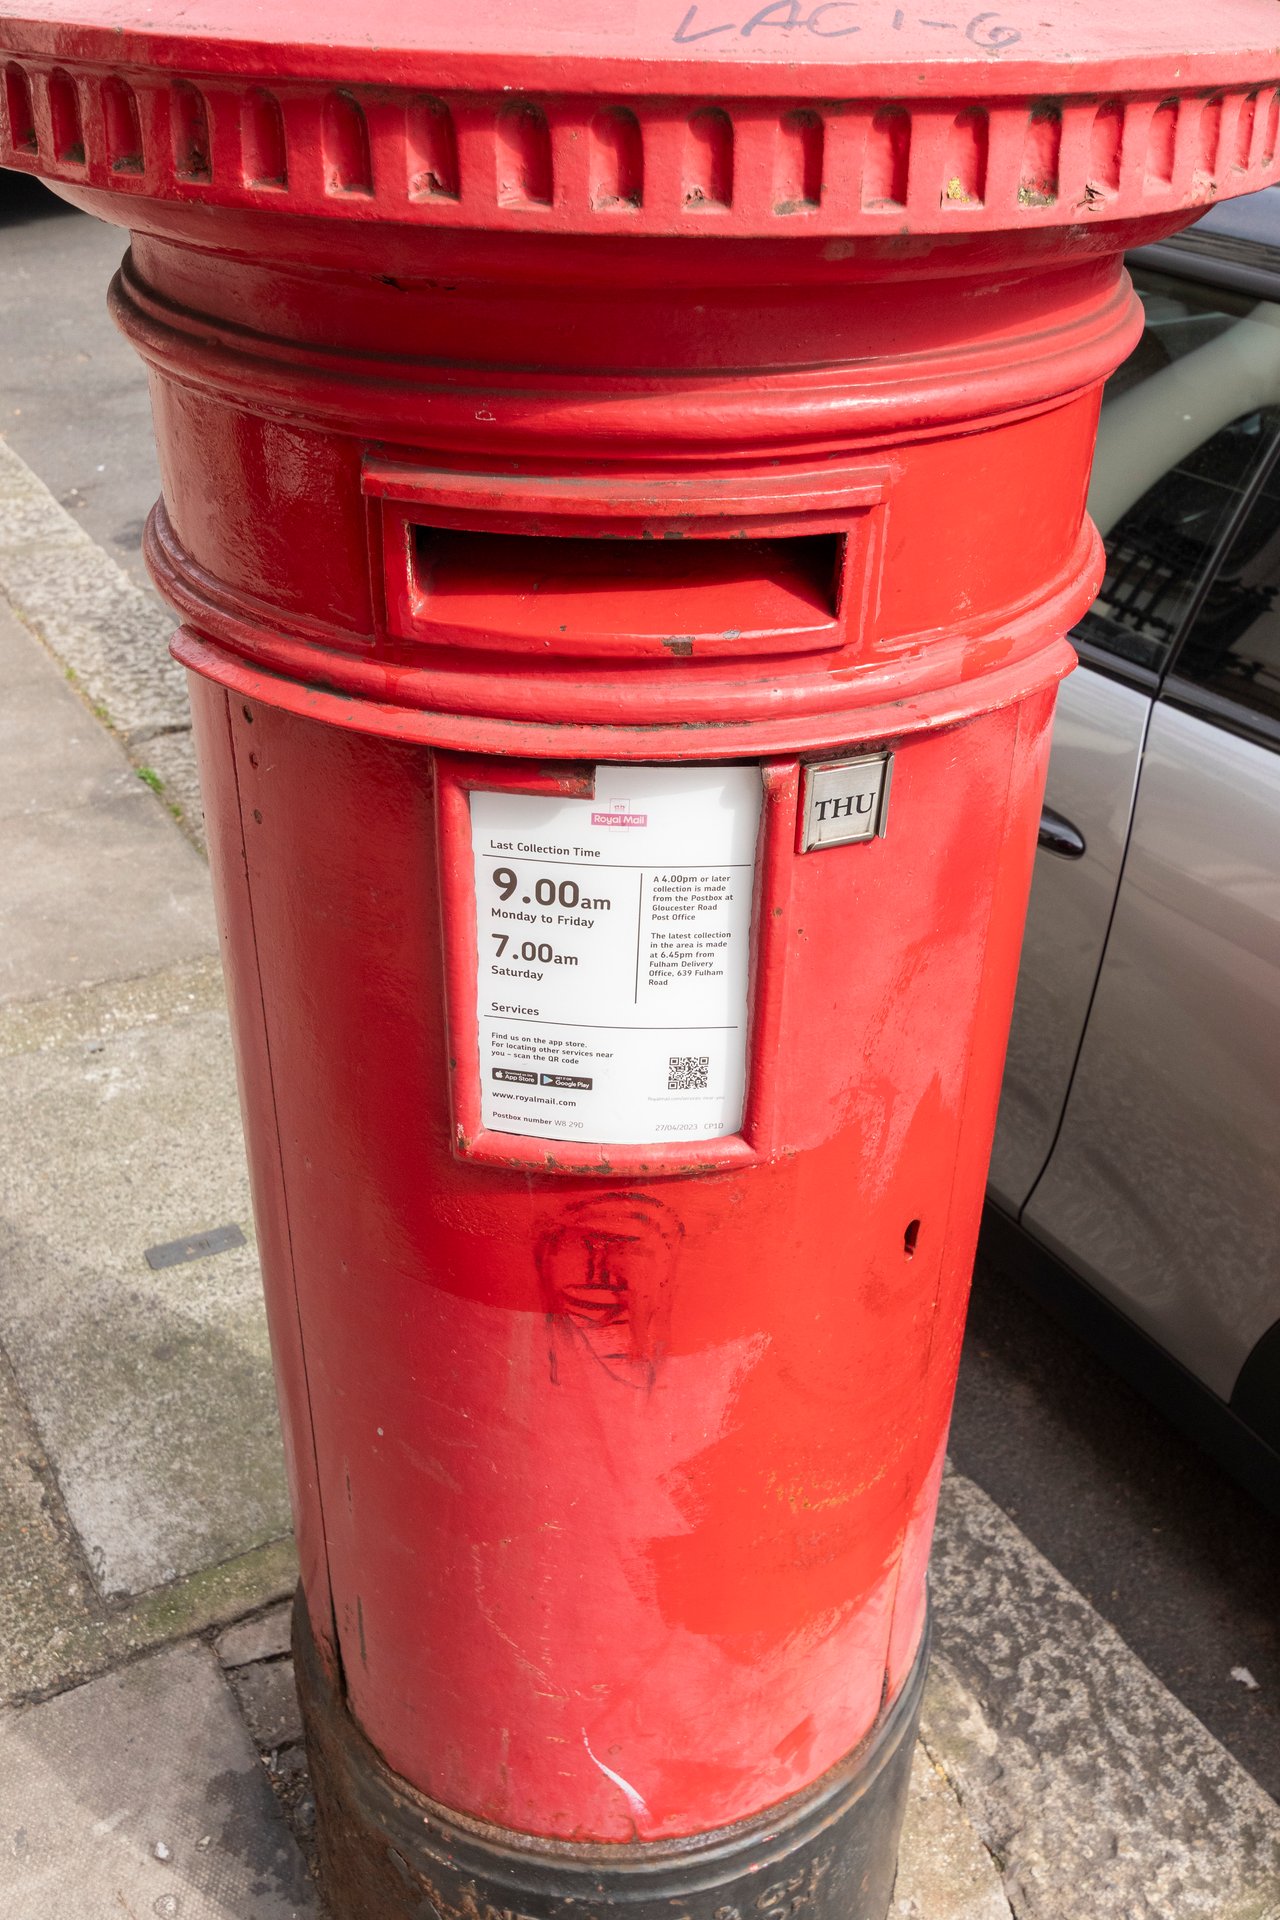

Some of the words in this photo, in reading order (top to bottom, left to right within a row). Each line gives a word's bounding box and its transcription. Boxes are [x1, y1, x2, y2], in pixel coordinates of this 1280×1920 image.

[815, 792, 876, 822] THU
[594, 815, 621, 824] Royal
[624, 816, 644, 824] Mail
[490, 840, 513, 850] Last
[518, 843, 570, 856] Collection
[573, 848, 601, 858] Time
[662, 875, 697, 884] 4.00pm
[493, 868, 611, 910] 9.00am
[492, 908, 537, 924] Monday
[542, 915, 553, 924] to
[558, 916, 594, 928] Friday
[492, 933, 578, 965] 7.00am
[661, 952, 693, 960] 6.45pm
[492, 965, 544, 981] Saturday
[492, 1002, 540, 1016] Services
[492, 1032, 508, 1040] Find
[507, 1042, 537, 1053] locating
[562, 1049, 593, 1057] services
[492, 1092, 577, 1107] www.royalmail.com
[493, 1111, 521, 1121] Postbox
[524, 1117, 552, 1125] number
